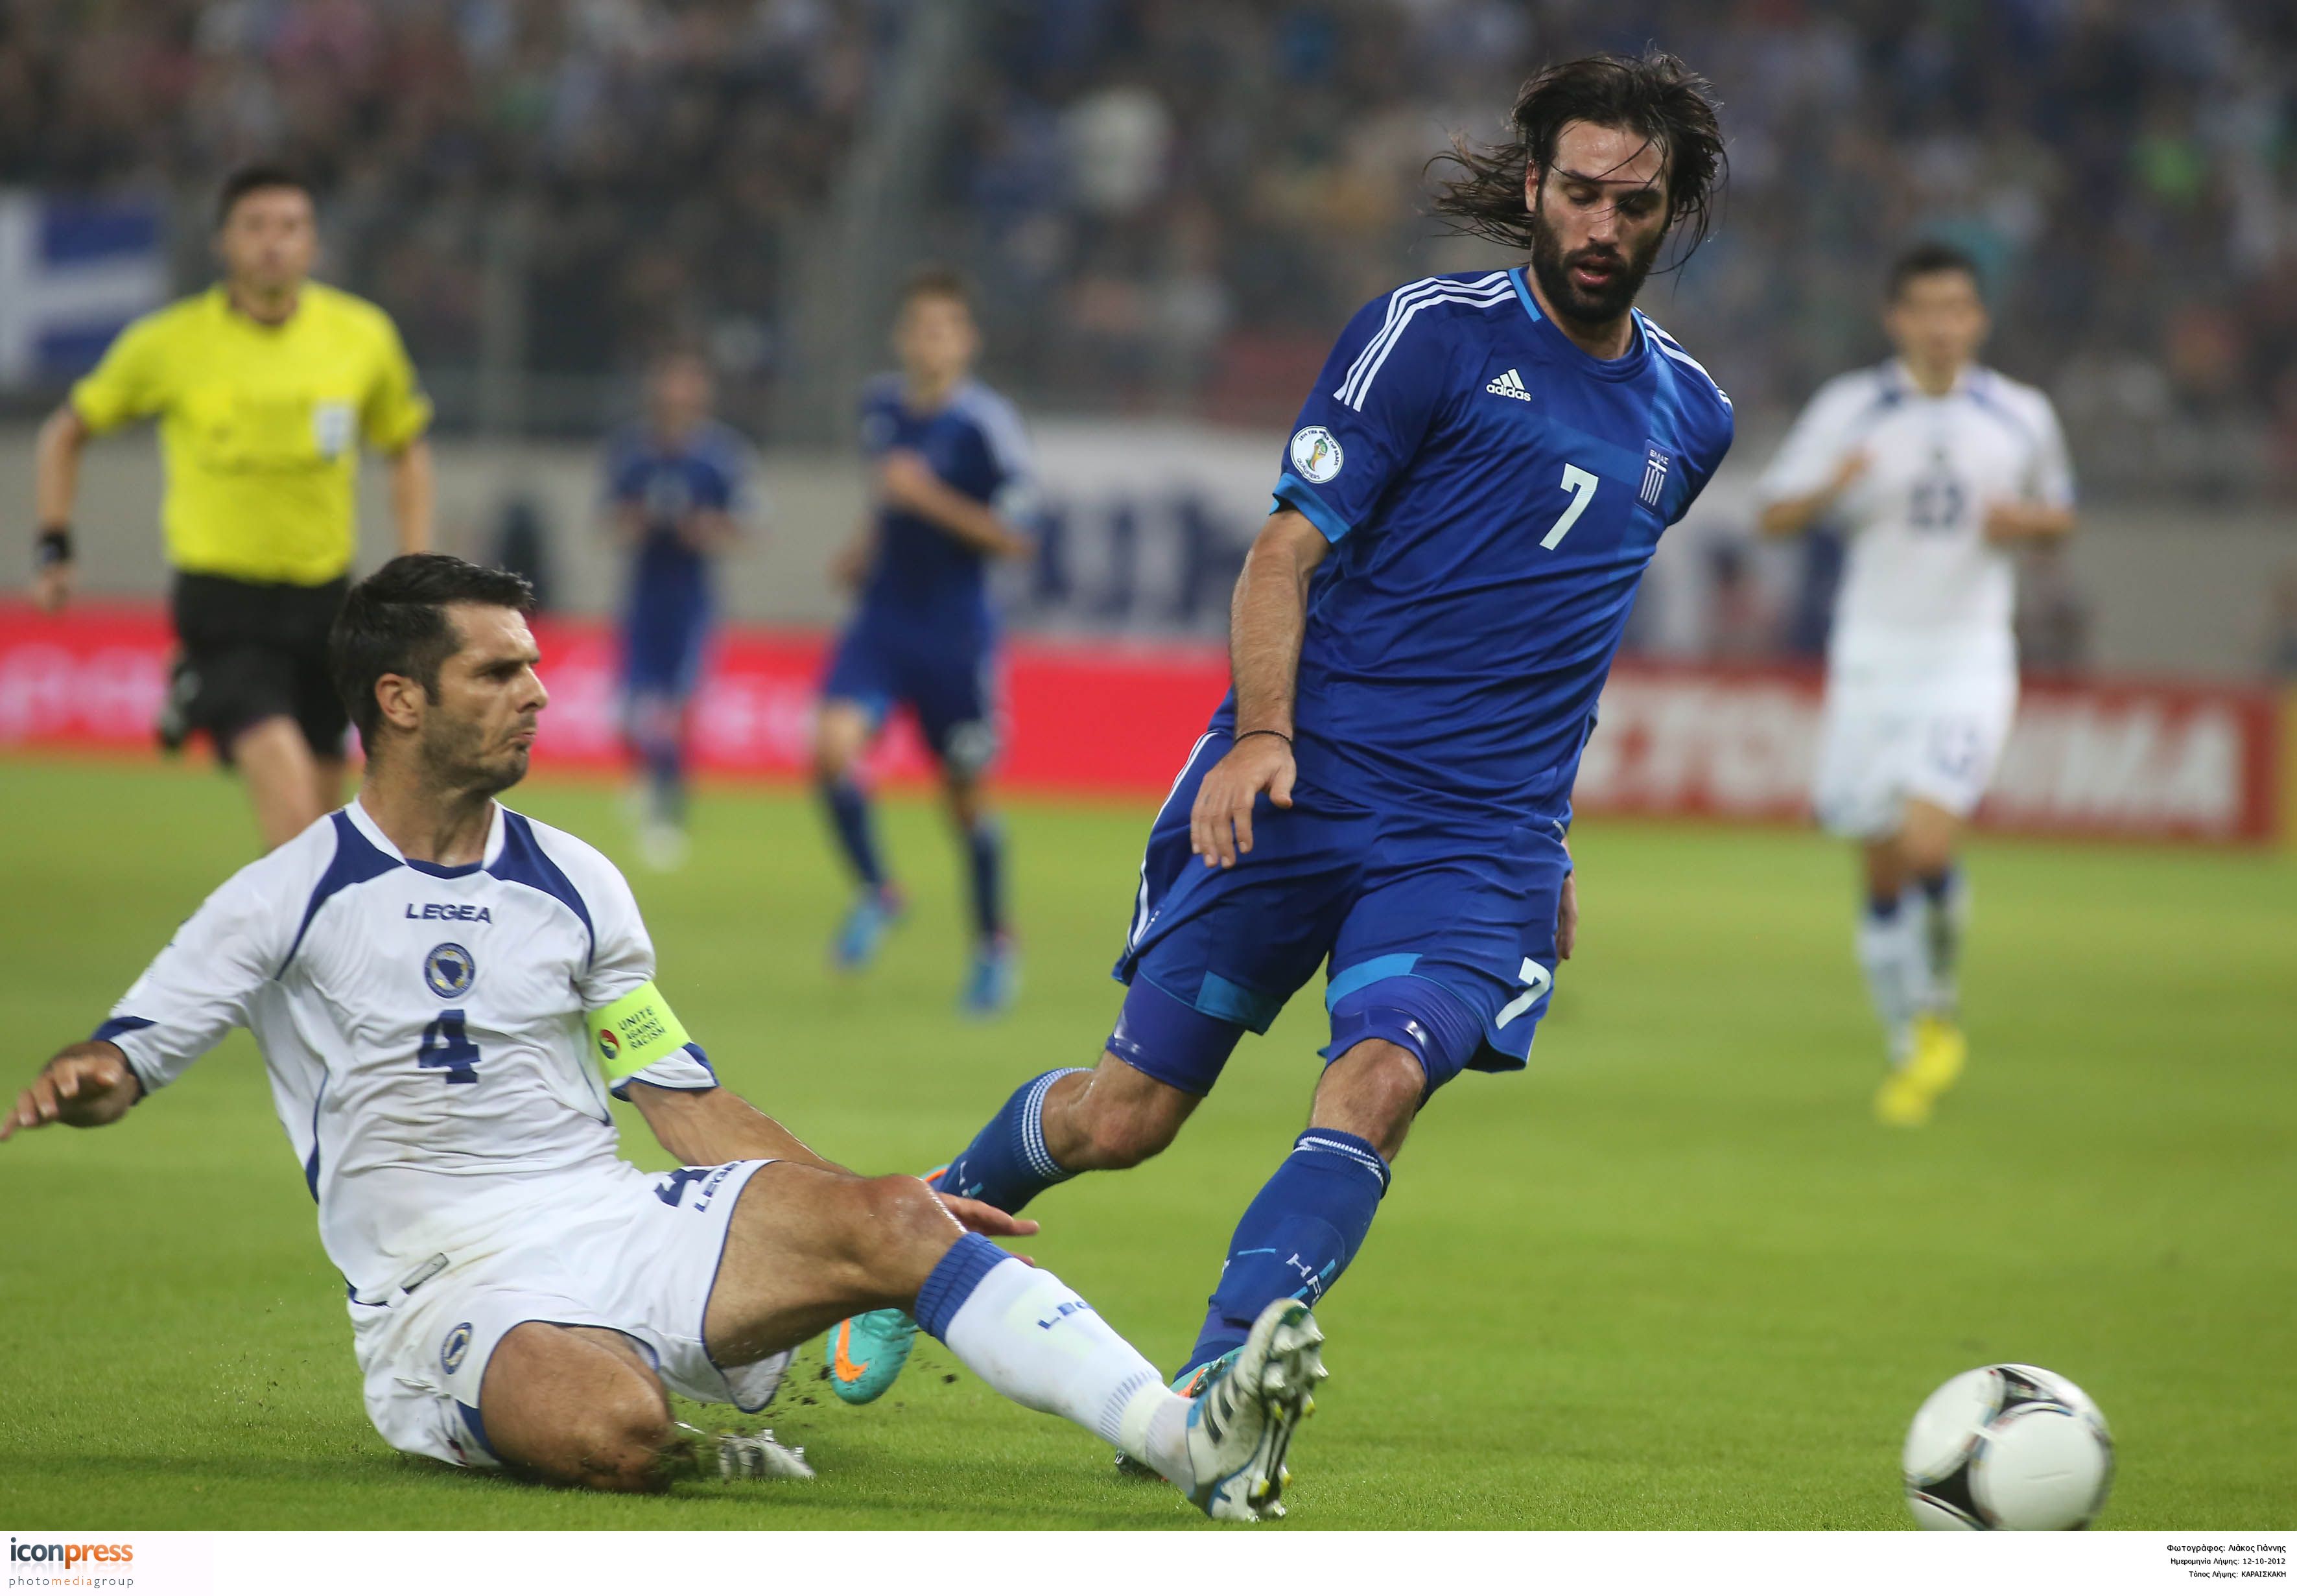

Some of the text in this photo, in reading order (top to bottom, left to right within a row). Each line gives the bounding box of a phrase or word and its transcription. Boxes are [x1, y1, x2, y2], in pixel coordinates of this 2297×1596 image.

[1486, 384, 1531, 401] adidas
[1539, 462, 1599, 550] 7
[405, 903, 493, 924] LEGEA
[1495, 956, 1552, 1030] 7
[617, 1005, 655, 1031] UNITE
[626, 1018, 659, 1040] AGAINST
[418, 1009, 481, 1084] 4
[630, 1027, 666, 1051] RACISM
